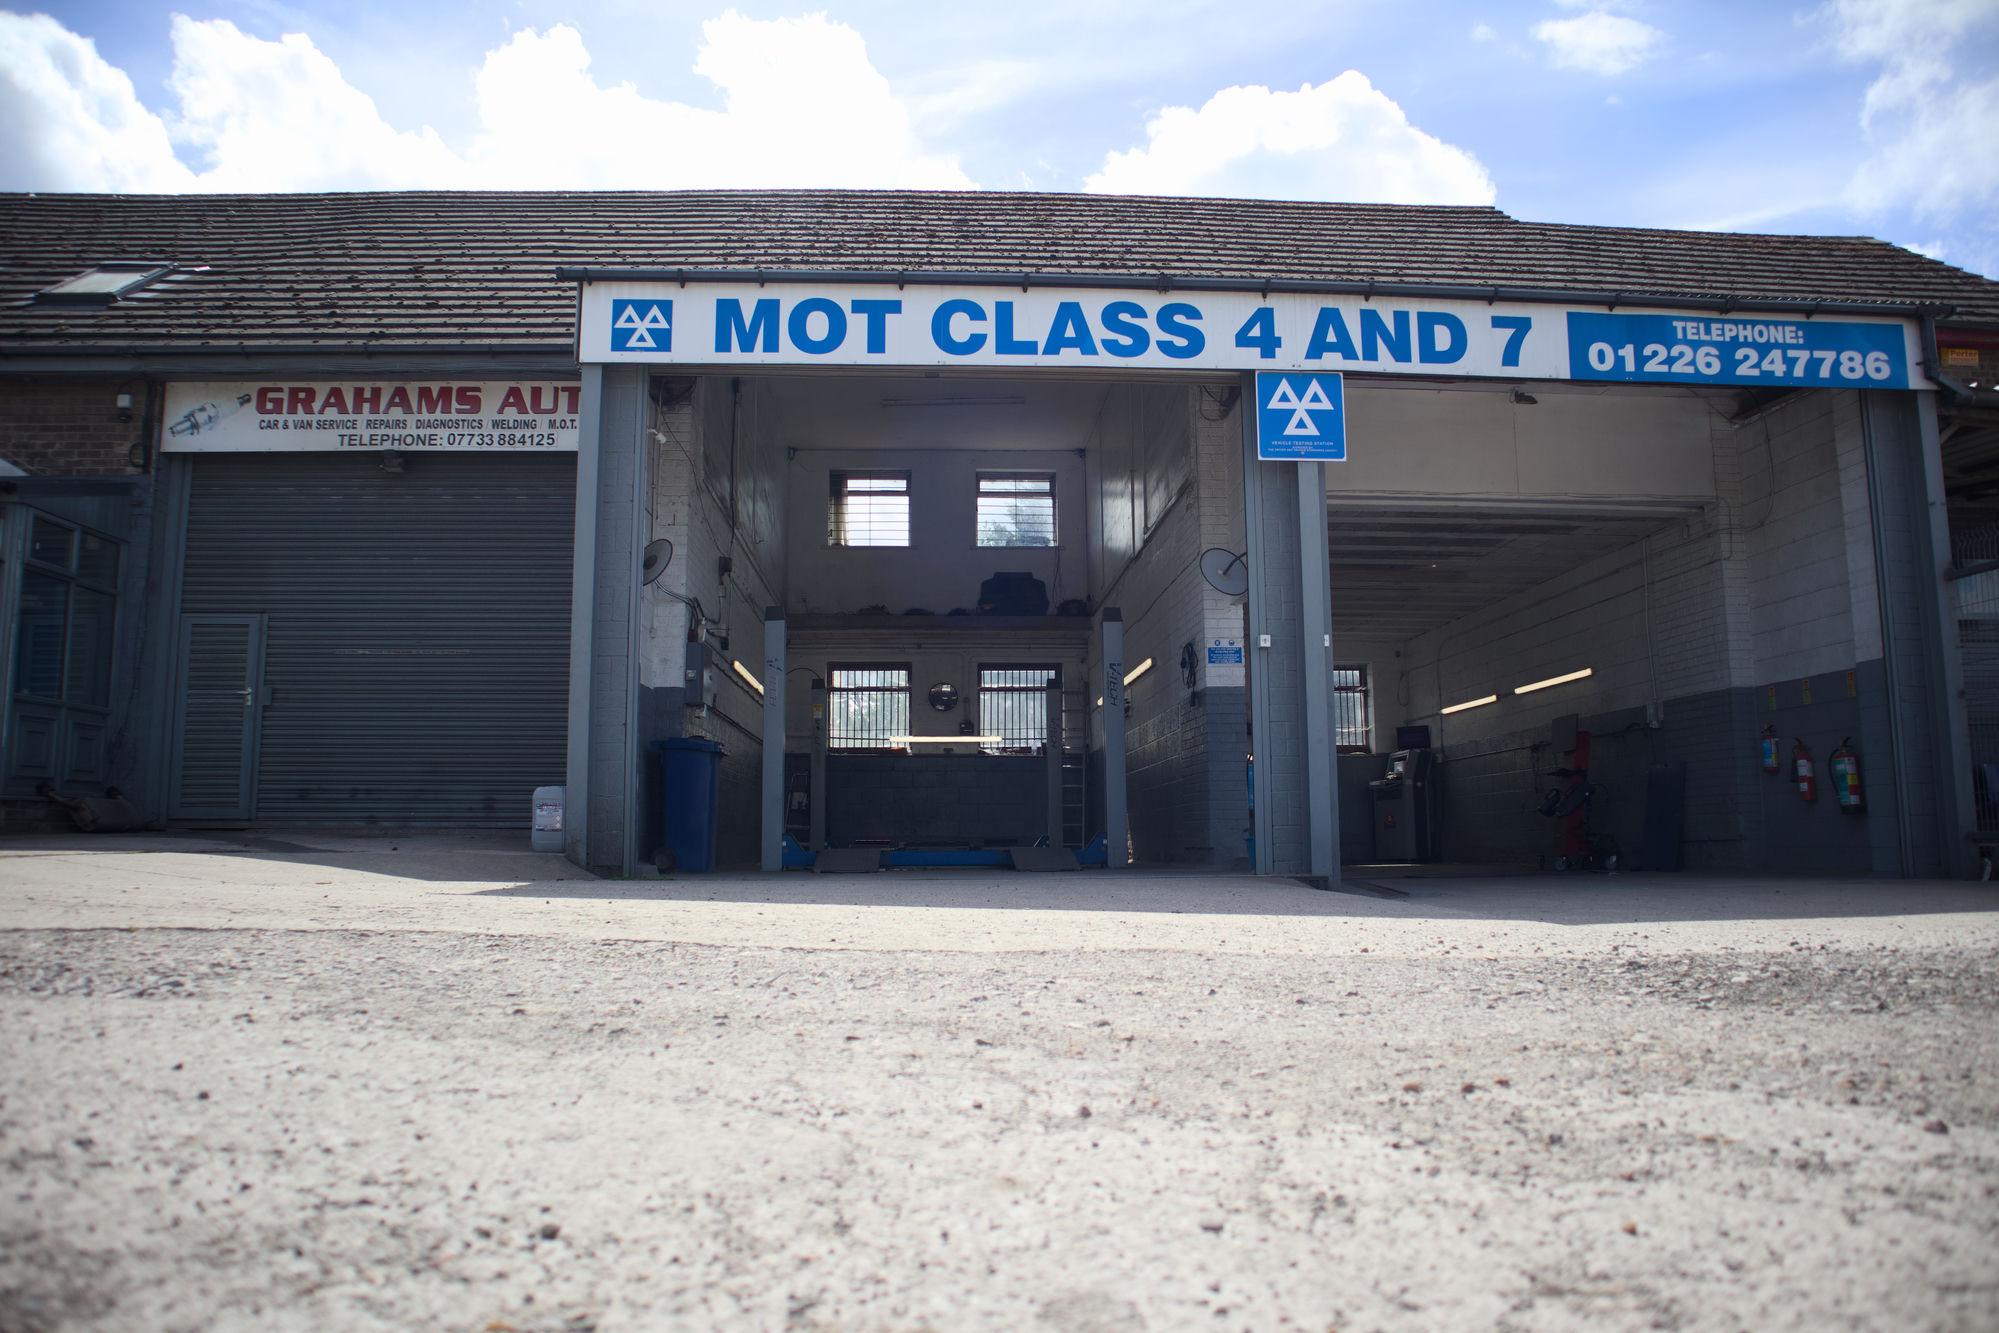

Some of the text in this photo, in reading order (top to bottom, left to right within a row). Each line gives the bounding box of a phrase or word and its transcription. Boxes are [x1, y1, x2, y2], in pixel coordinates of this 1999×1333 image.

[714, 298, 1532, 367] MOT CLASS 4 AND 7
[1673, 321, 1804, 344] TELEPHONE:
[1588, 342, 1891, 380] 01226 247786
[255, 386, 581, 415] GRAHAMS AUT
[259, 419, 577, 430] CAR & VAN SERVICE REPAIRS DIAGNOSTICS WELDING M.O.T.
[338, 433, 443, 447] TELEPHONE:
